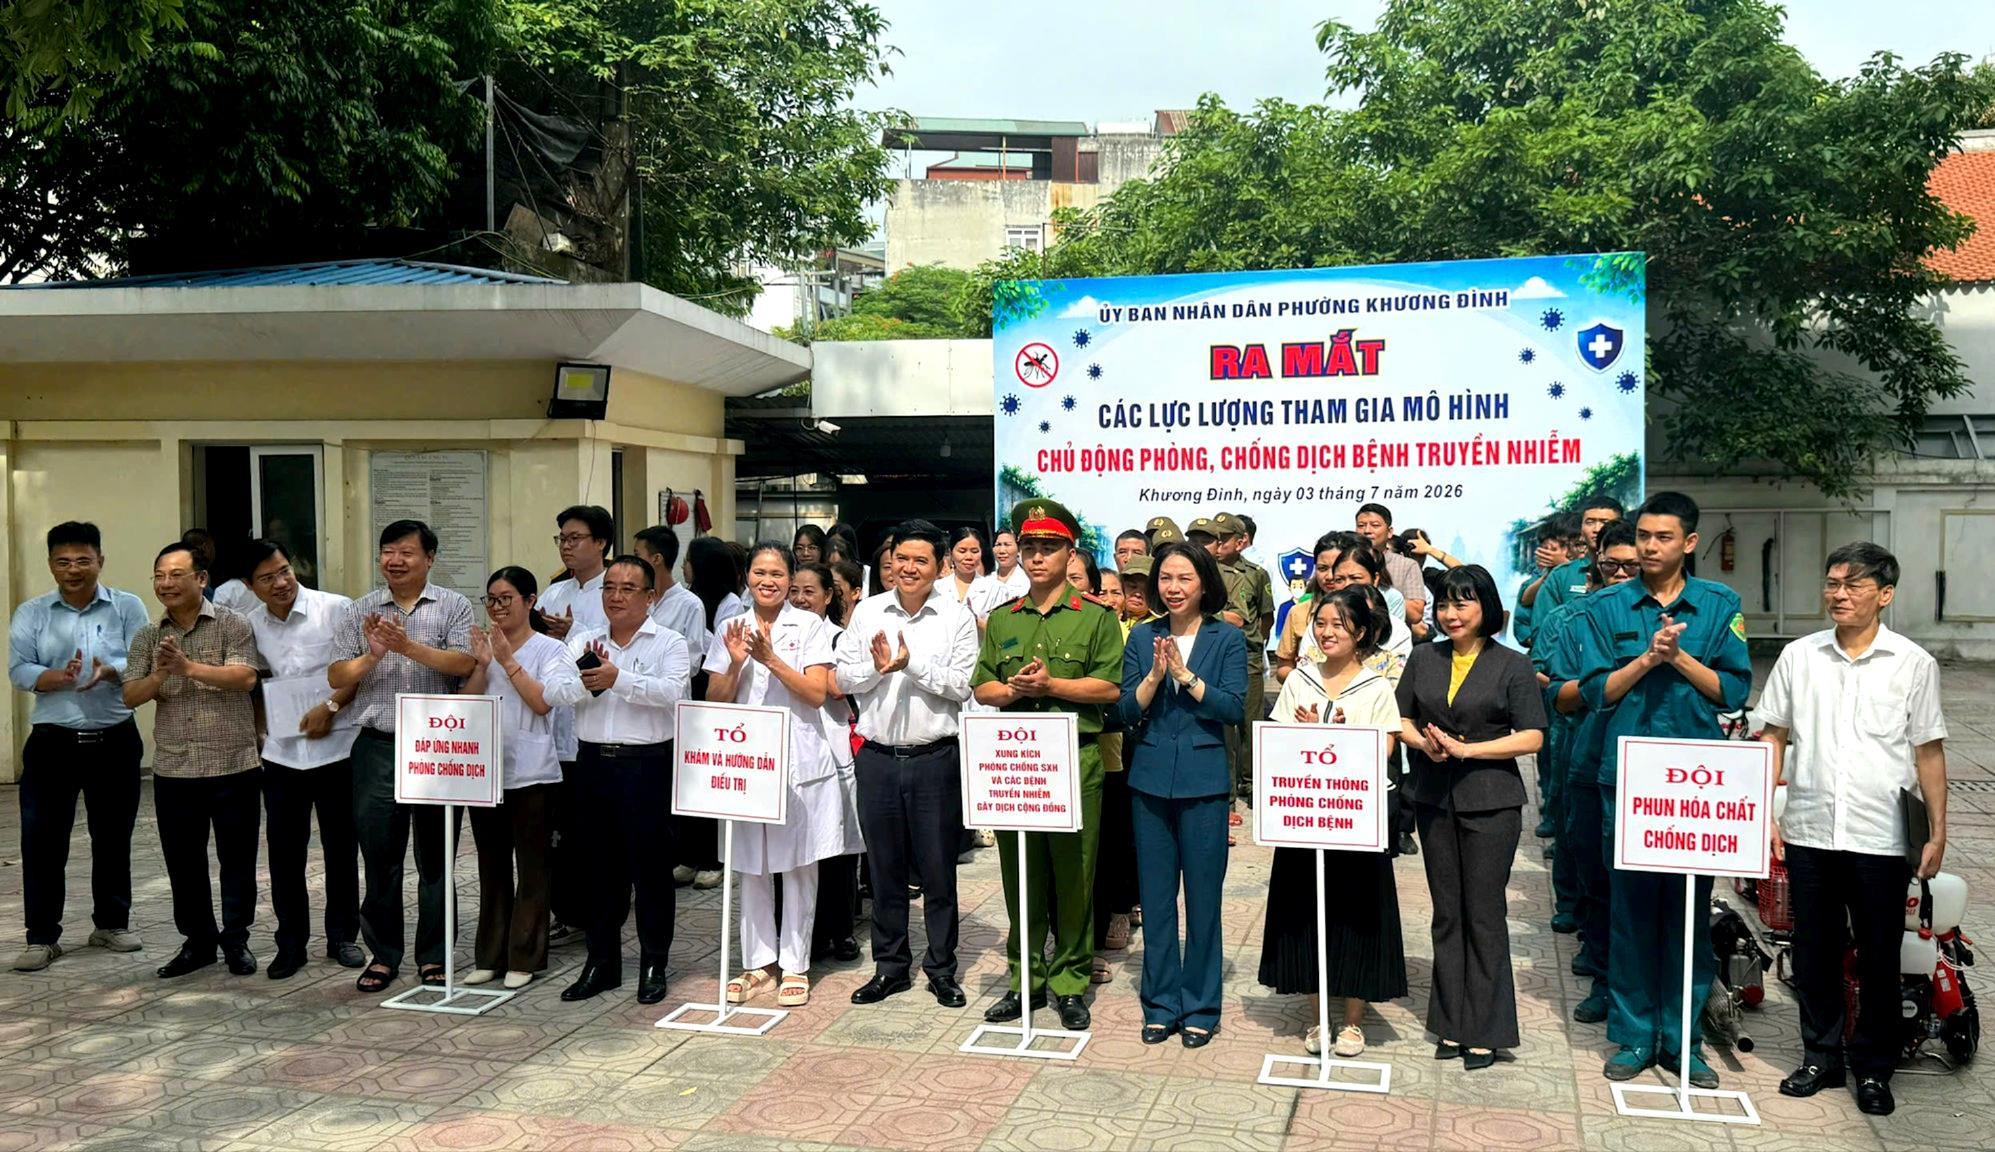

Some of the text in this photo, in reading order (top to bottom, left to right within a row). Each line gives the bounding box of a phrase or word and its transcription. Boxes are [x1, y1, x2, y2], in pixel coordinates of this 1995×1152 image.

[1100, 289, 1508, 323] ỦY BAN NHÂN DÂN PHƯỜNG KHƯƠNG ĐÌNH
[1210, 328, 1385, 380] RA MẮT
[1098, 388, 1509, 433] CÁC LỰC LƯỢNG THAM GIA MÔ HÌNH
[1037, 429, 1581, 477] CHỦ ĐỘNG PHÒNG, CHỐNG DỊCH BỆNH TRUYỀN NHIỄM
[1139, 488, 1202, 504] Khương
[1253, 486, 1292, 504] ngày
[1296, 486, 1314, 500] 03
[1319, 486, 1366, 503] tháng
[1371, 486, 1380, 500] 7
[1383, 484, 1418, 499] năm
[1424, 484, 1463, 498] 2026
[428, 714, 466, 732] ĐỘI
[714, 722, 747, 743] TỔ
[997, 727, 1037, 744] ĐỘI
[415, 737, 431, 753] ĐÁP
[451, 742, 480, 755] NHANH
[995, 748, 1041, 758] XUNG KÍCH
[1300, 743, 1337, 765] TỔ
[684, 749, 710, 765] KHÁM
[437, 759, 464, 777] CHỐNG
[466, 764, 485, 780] DỊCH
[1041, 763, 1058, 772] SXH
[1665, 764, 1725, 789] ĐỘI
[733, 778, 747, 795] TRỊ
[1325, 776, 1369, 791] THÔNG
[995, 803, 1015, 813] DỊCH
[1269, 793, 1363, 810] PHÒNG CHỐNG
[1632, 795, 1756, 821] PHUN HÓA CHẤT
[1283, 815, 1353, 831] DỊCH BỆNH
[1643, 824, 1738, 856] CHỐNG DỊCH
